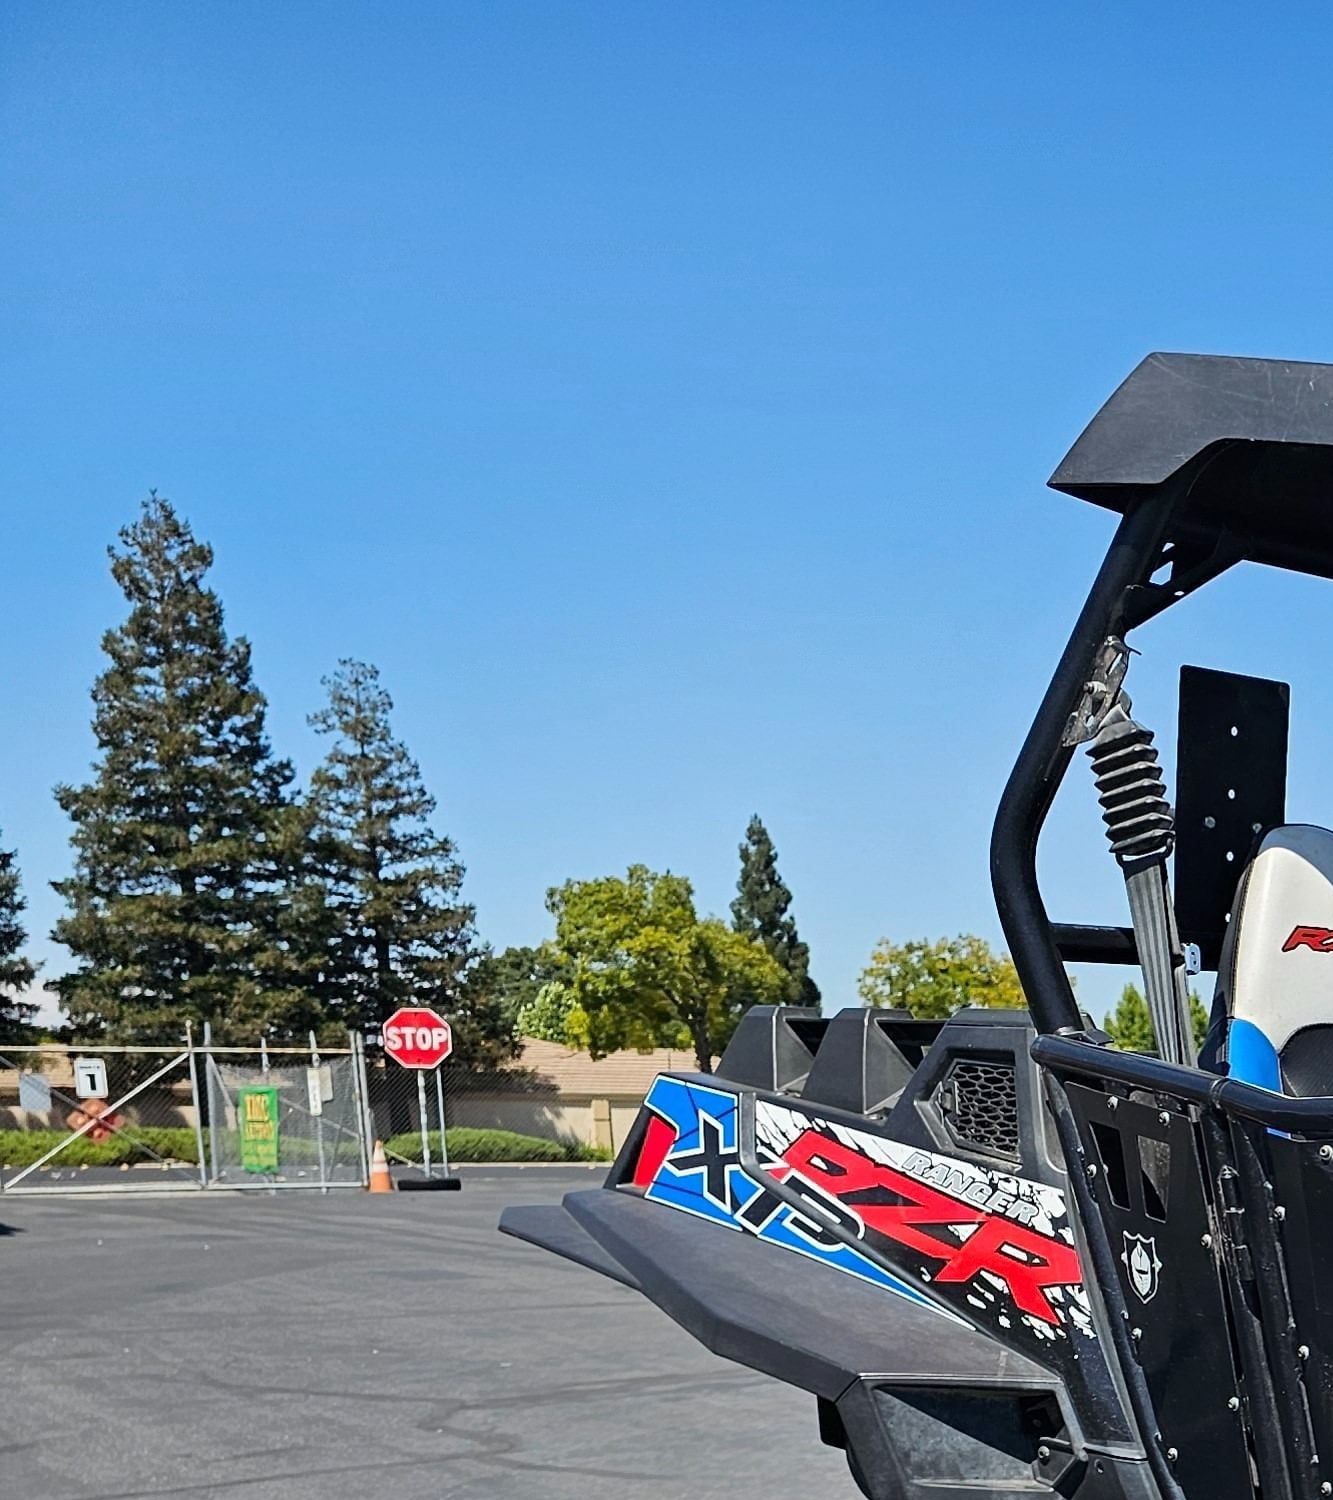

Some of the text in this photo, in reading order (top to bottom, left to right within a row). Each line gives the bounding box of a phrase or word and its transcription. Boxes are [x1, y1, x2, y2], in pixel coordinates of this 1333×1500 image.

[387, 1026, 449, 1051] STOP
[85, 1074, 97, 1091] 1
[664, 1109, 866, 1252] XP
[901, 1151, 1040, 1223] RANGER
[768, 1129, 1083, 1326] RZR
